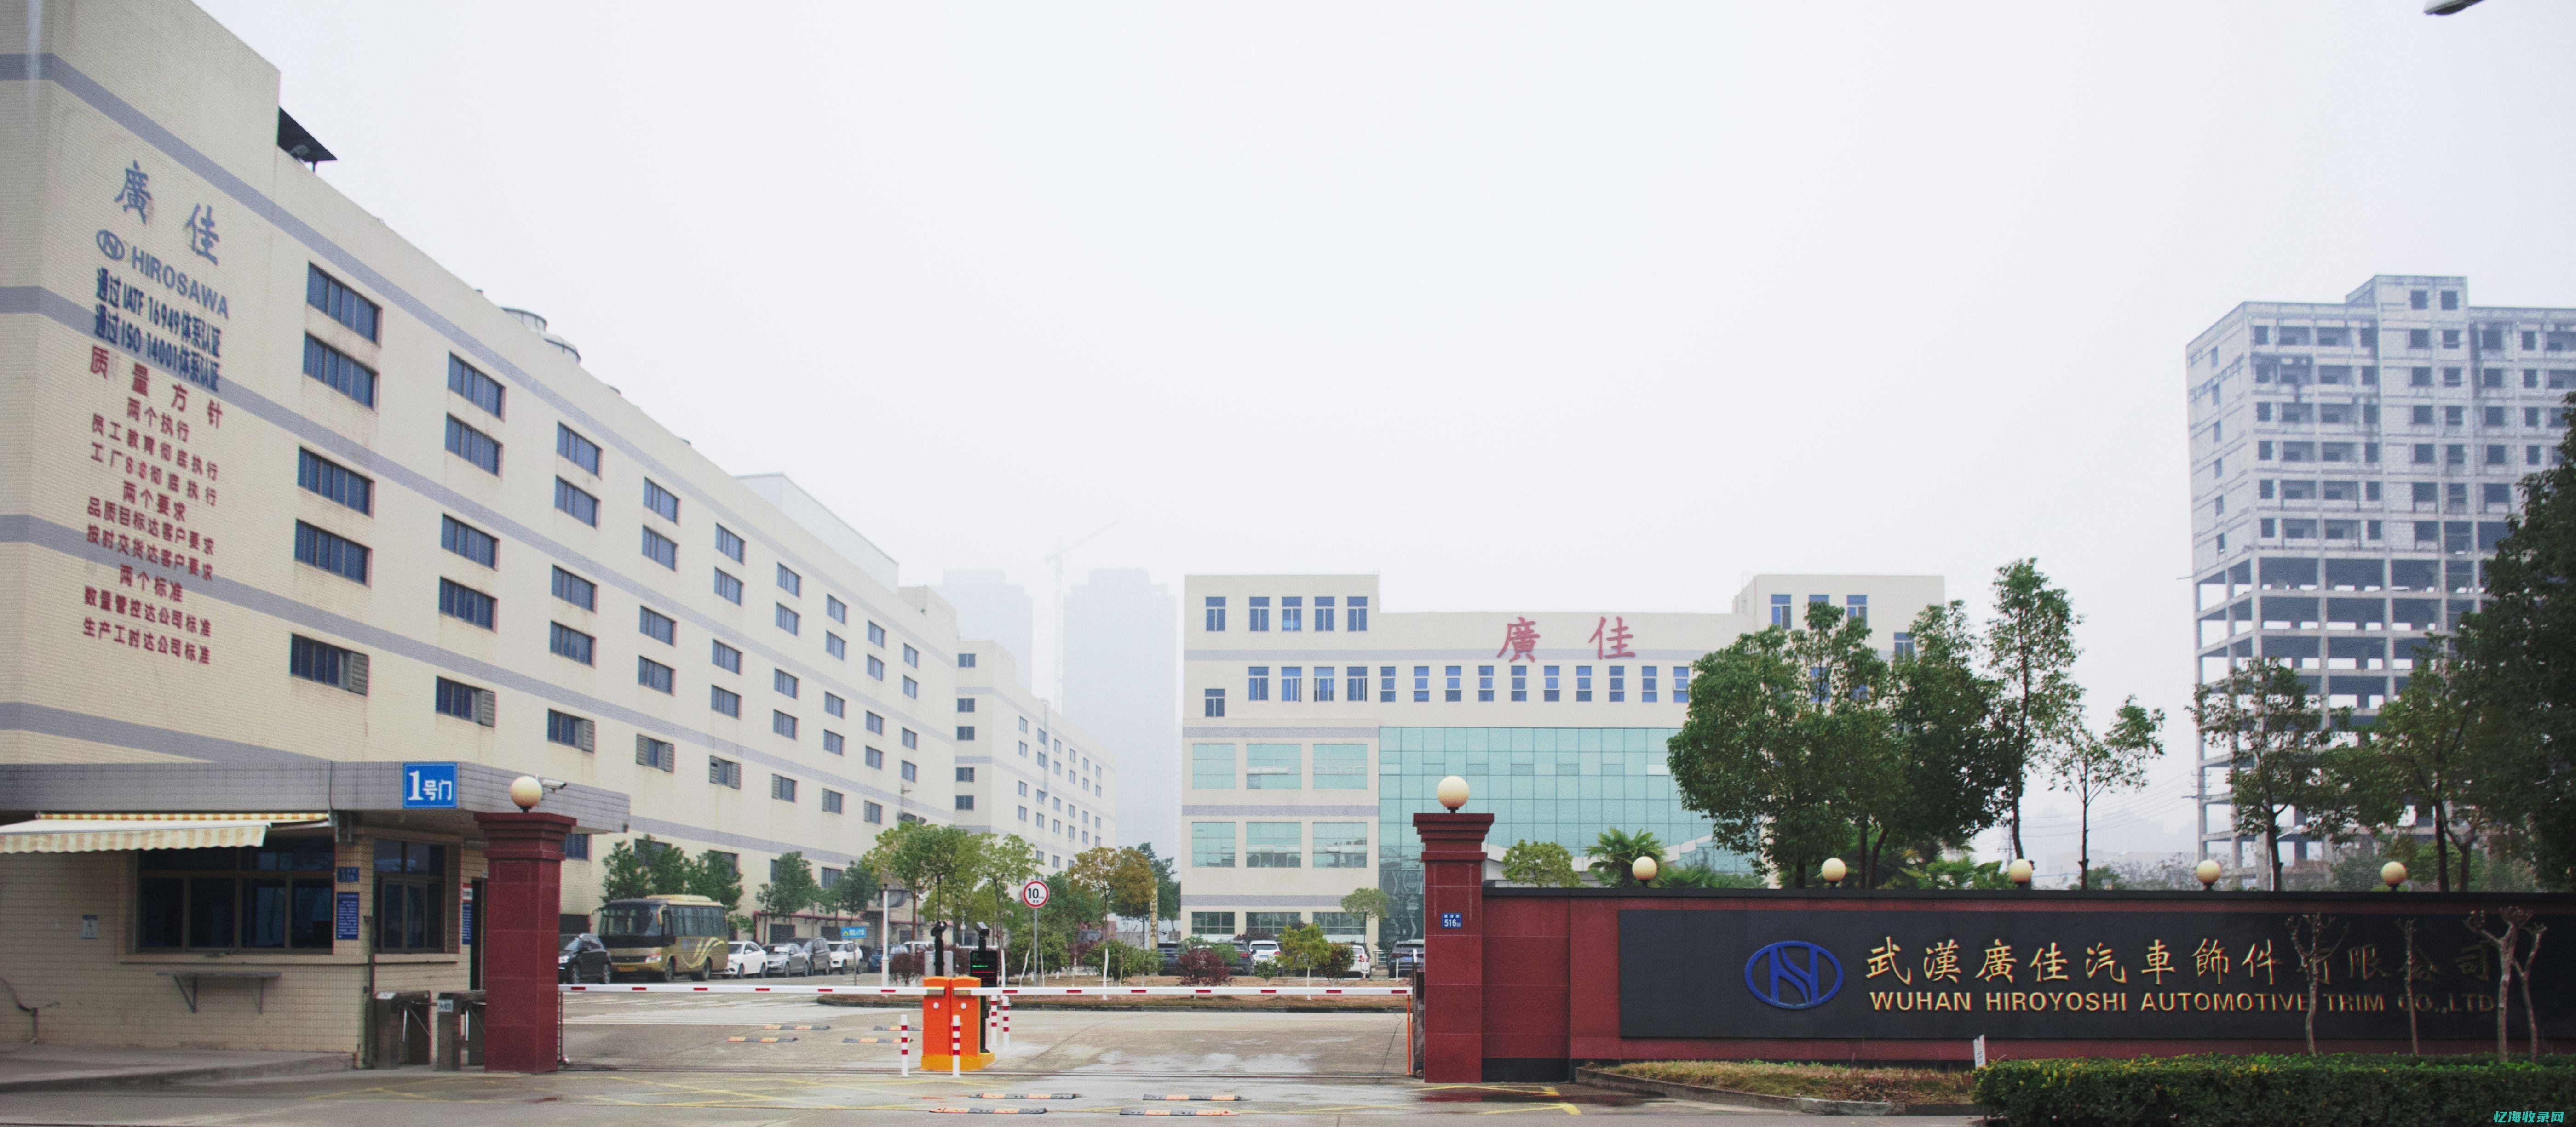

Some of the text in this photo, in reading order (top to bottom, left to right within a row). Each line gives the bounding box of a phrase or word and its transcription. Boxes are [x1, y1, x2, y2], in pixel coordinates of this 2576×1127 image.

[114, 159, 219, 266] 廣佳
[131, 245, 229, 320] HIROSAWA
[90, 345, 224, 429] 质量方针
[127, 396, 189, 443] 两个执行
[123, 479, 186, 522] 两个要求
[87, 496, 214, 556] 品质目标达客户要求
[86, 523, 214, 581] 按时交货达客户要求
[119, 563, 183, 603] 两个标准
[83, 616, 210, 664] 生产工时达公司标准
[1497, 616, 1636, 663] 廣佳
[408, 770, 452, 801] 1号门
[1028, 888, 1039, 899] 10
[1869, 991, 1971, 1012] WUHAN
[1985, 991, 2128, 1012] HIROYOSHI
[2140, 992, 2309, 1012] AUTOMOTIVE
[2323, 993, 2385, 1012] TRIM
